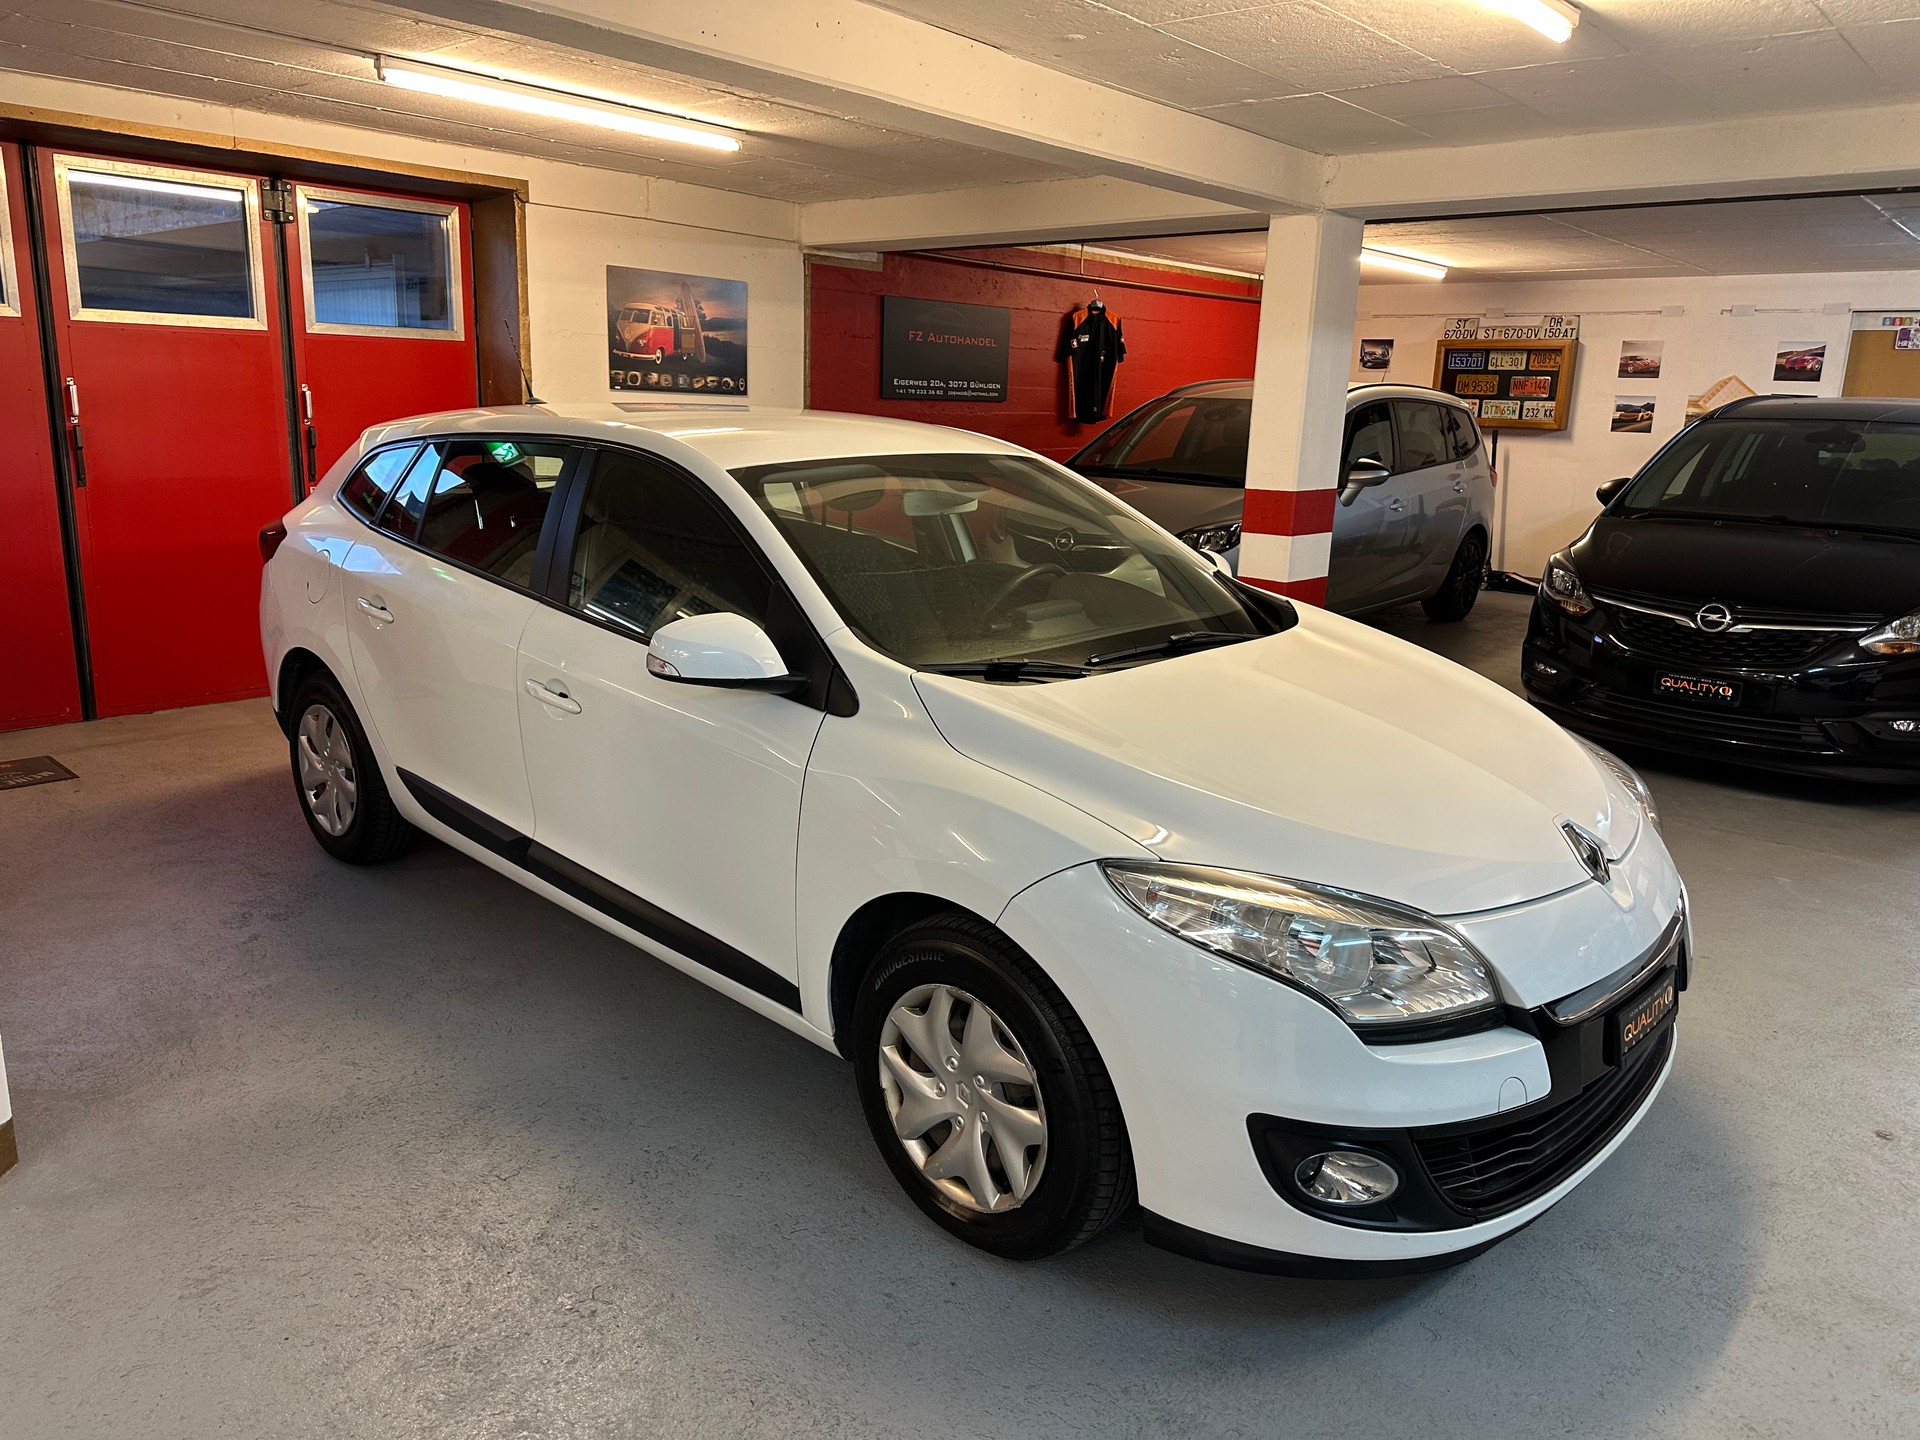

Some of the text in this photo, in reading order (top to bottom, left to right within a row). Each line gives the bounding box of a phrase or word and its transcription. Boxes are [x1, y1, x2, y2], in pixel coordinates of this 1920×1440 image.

[1455, 320, 1468, 329] ST
[1549, 317, 1563, 328] DR
[1484, 328, 1496, 339] ST
[909, 331, 997, 347] FZ AUTOHANDEL
[948, 380, 967, 388] 3073
[1525, 408, 1554, 418] 232 KK
